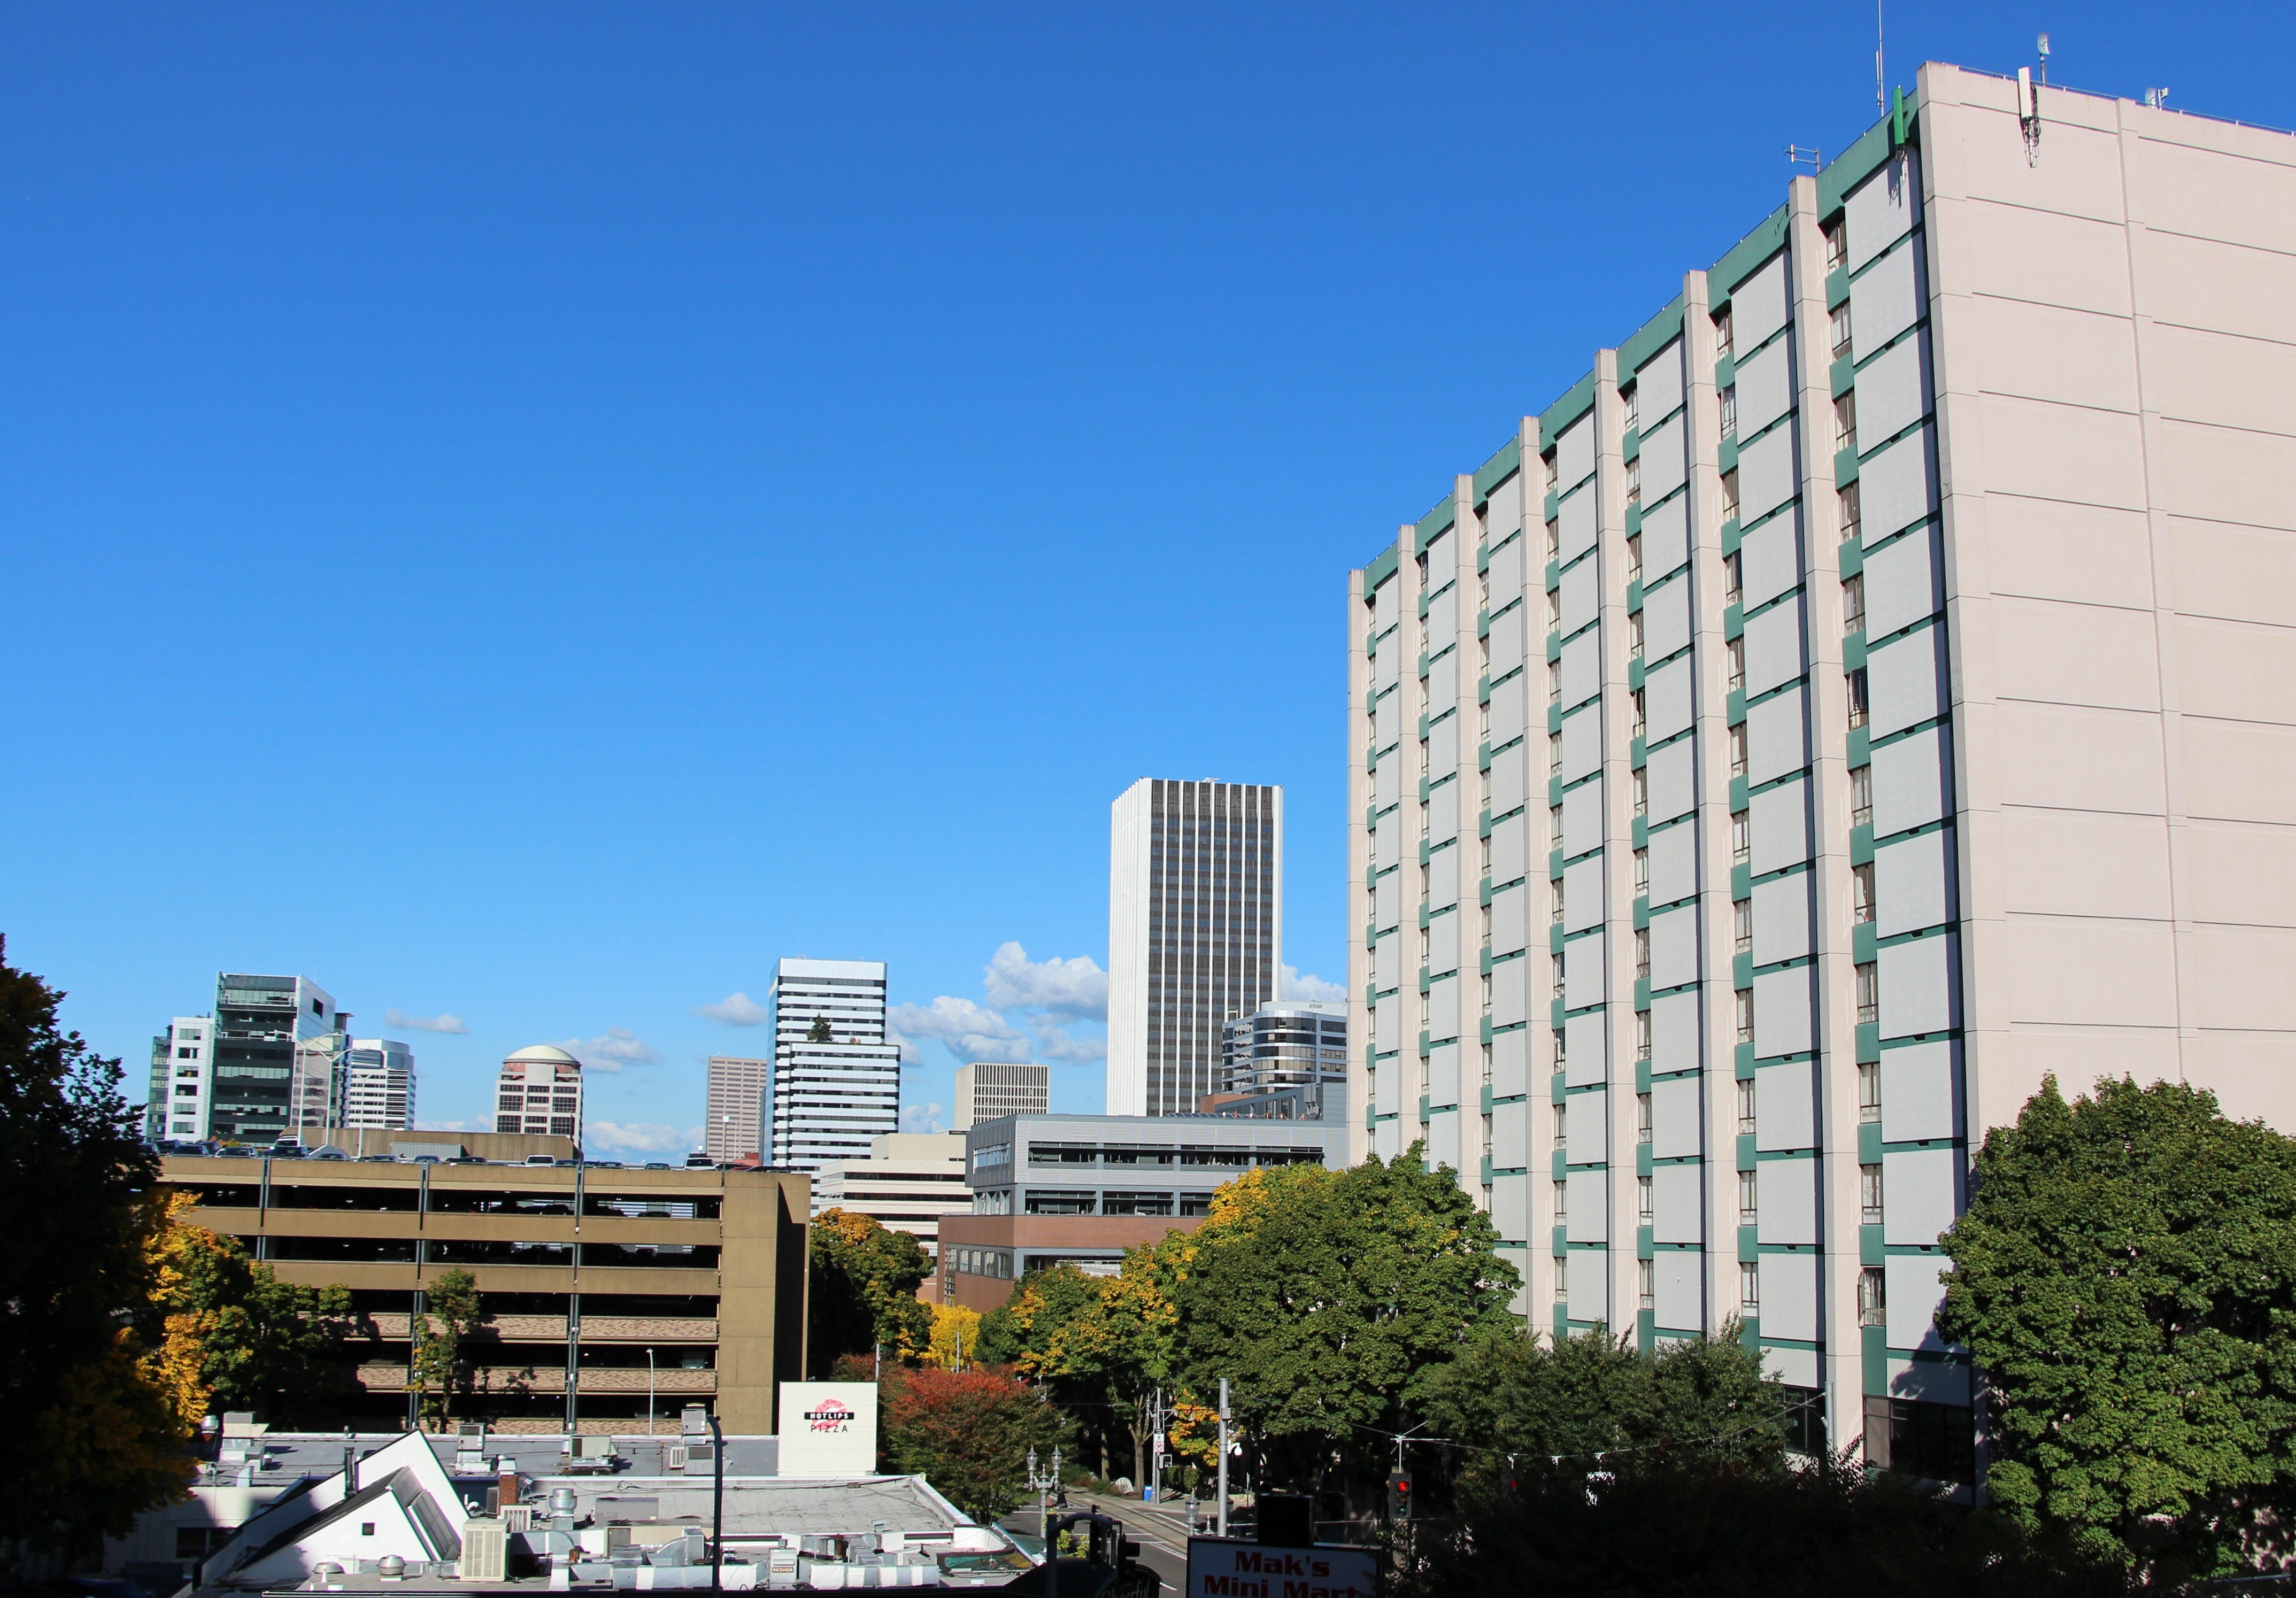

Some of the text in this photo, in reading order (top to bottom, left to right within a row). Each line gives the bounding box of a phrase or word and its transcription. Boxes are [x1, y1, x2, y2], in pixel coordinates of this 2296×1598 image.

[1235, 1550, 1330, 1577] Mak's
[1204, 1574, 1361, 1598] Mini Mart
